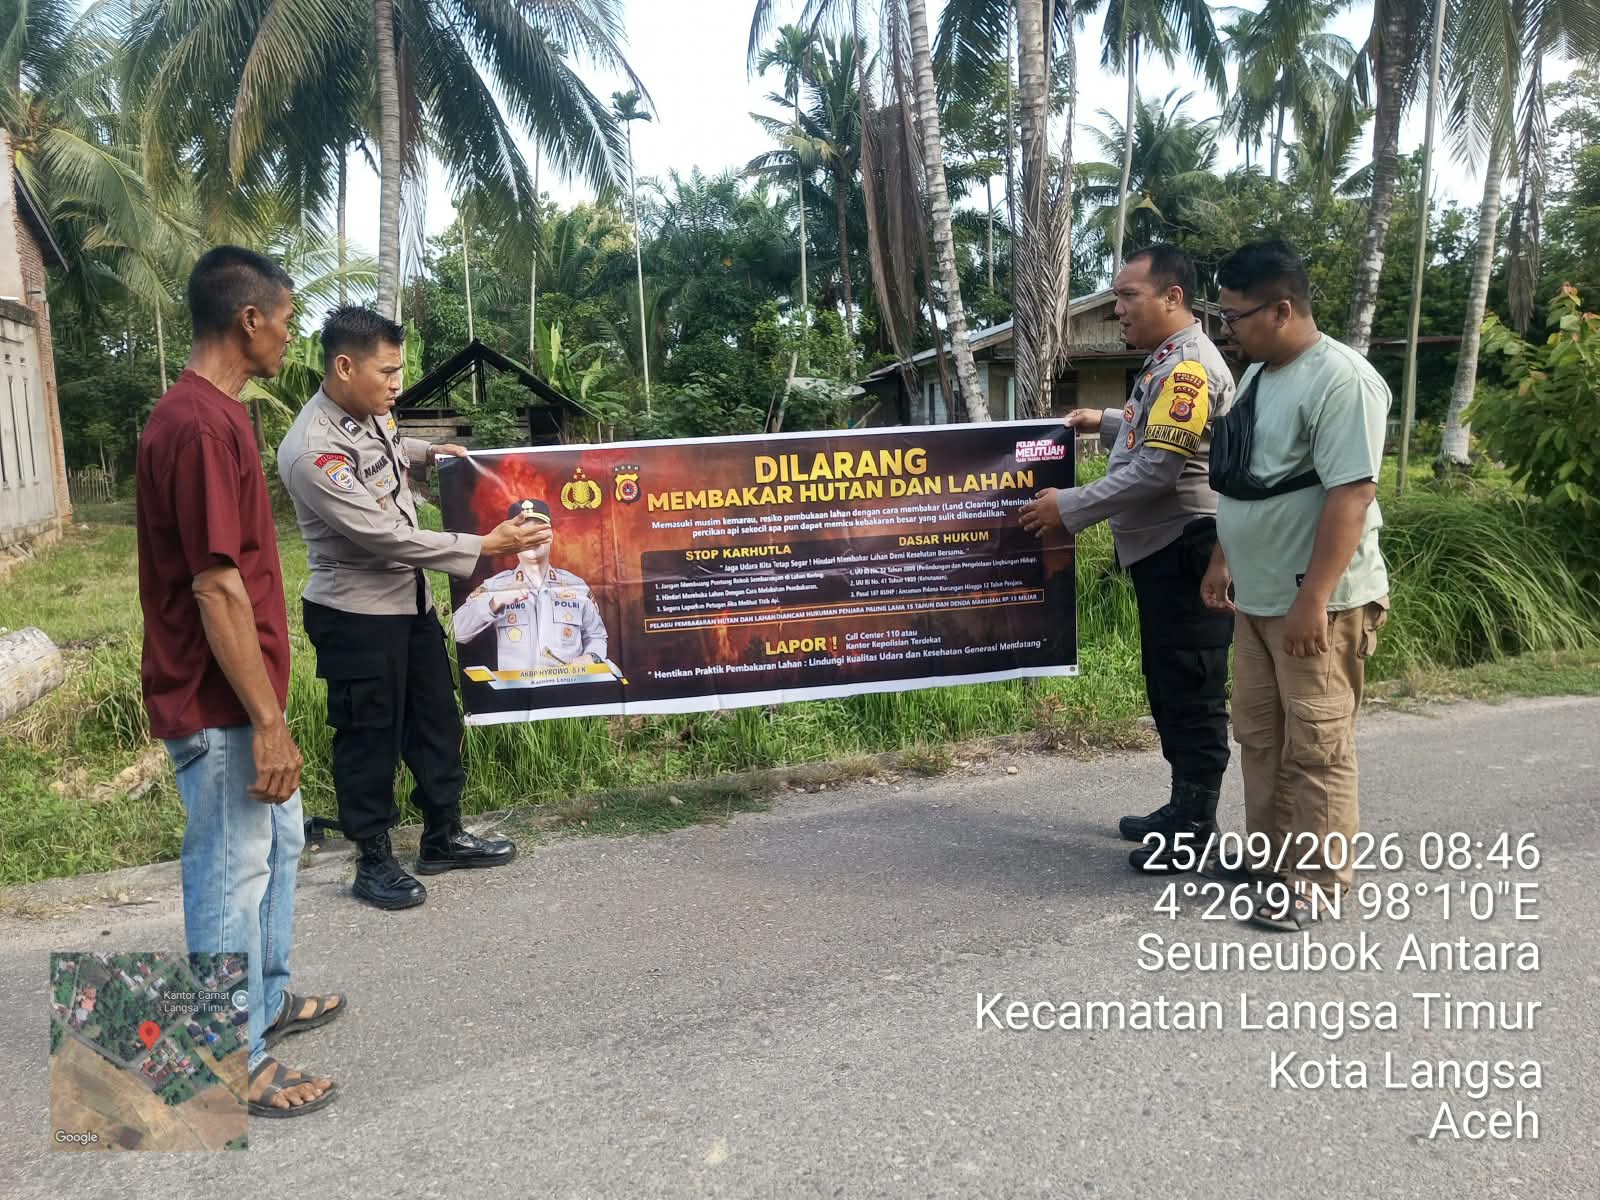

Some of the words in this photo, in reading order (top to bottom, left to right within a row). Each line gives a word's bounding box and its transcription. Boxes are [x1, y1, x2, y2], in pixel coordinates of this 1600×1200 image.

[1015, 445, 1064, 457] MEUTUAH
[754, 446, 926, 484] DILARANG
[647, 484, 793, 511] MEMBAKAR
[799, 479, 882, 502] HUTAN
[890, 476, 941, 496] DAN
[948, 470, 1033, 492] LAHAN
[651, 519, 692, 529] Memasuki
[694, 517, 720, 526] musim
[722, 515, 757, 525] kemarau,
[759, 513, 782, 522] resiko
[783, 510, 828, 522] pembukaan
[830, 509, 850, 518] lahan
[852, 507, 878, 518] dengan
[900, 503, 939, 513] membakar
[942, 501, 963, 512] (Land
[964, 499, 999, 510] Clearing)
[692, 528, 725, 538] percikan
[727, 527, 739, 536] api
[740, 525, 766, 534] sekecil
[800, 521, 821, 531] dapat
[824, 519, 853, 528] memicu
[855, 517, 894, 526] kebakaran
[896, 515, 916, 524] besar
[918, 515, 936, 523] yang
[938, 512, 954, 521] sulit
[956, 509, 1006, 520] dikendalikan.
[899, 534, 939, 546] DASAR
[943, 530, 988, 543] HUKUM
[685, 549, 718, 560] STOP
[723, 544, 791, 558] KARHUTLA
[724, 563, 738, 573] Jaga
[739, 562, 757, 570] Udara
[790, 558, 807, 568] Segar
[813, 556, 835, 564] Hindari
[837, 553, 868, 563] Membakar
[870, 552, 888, 561] Lahan
[889, 551, 905, 559] Demi
[906, 549, 936, 558] Kesehatan
[554, 599, 579, 609] POLRI
[846, 641, 869, 649] Kantor
[872, 638, 908, 649] Kepolisian
[910, 636, 940, 644] Terdekat
[860, 631, 883, 639] Center
[765, 637, 826, 654] LAPOR
[654, 667, 692, 678] Hentikan
[694, 665, 723, 675] Praktik
[726, 661, 776, 673] Pembakaran
[778, 659, 802, 669] Lahan
[808, 656, 844, 668] Lindungi
[846, 653, 877, 663] Kualitas
[879, 651, 903, 660] Udara
[905, 650, 920, 658] dan
[922, 646, 962, 657] Kesehatan
[964, 643, 997, 653] Generasi
[999, 638, 1040, 651] Mendatang
